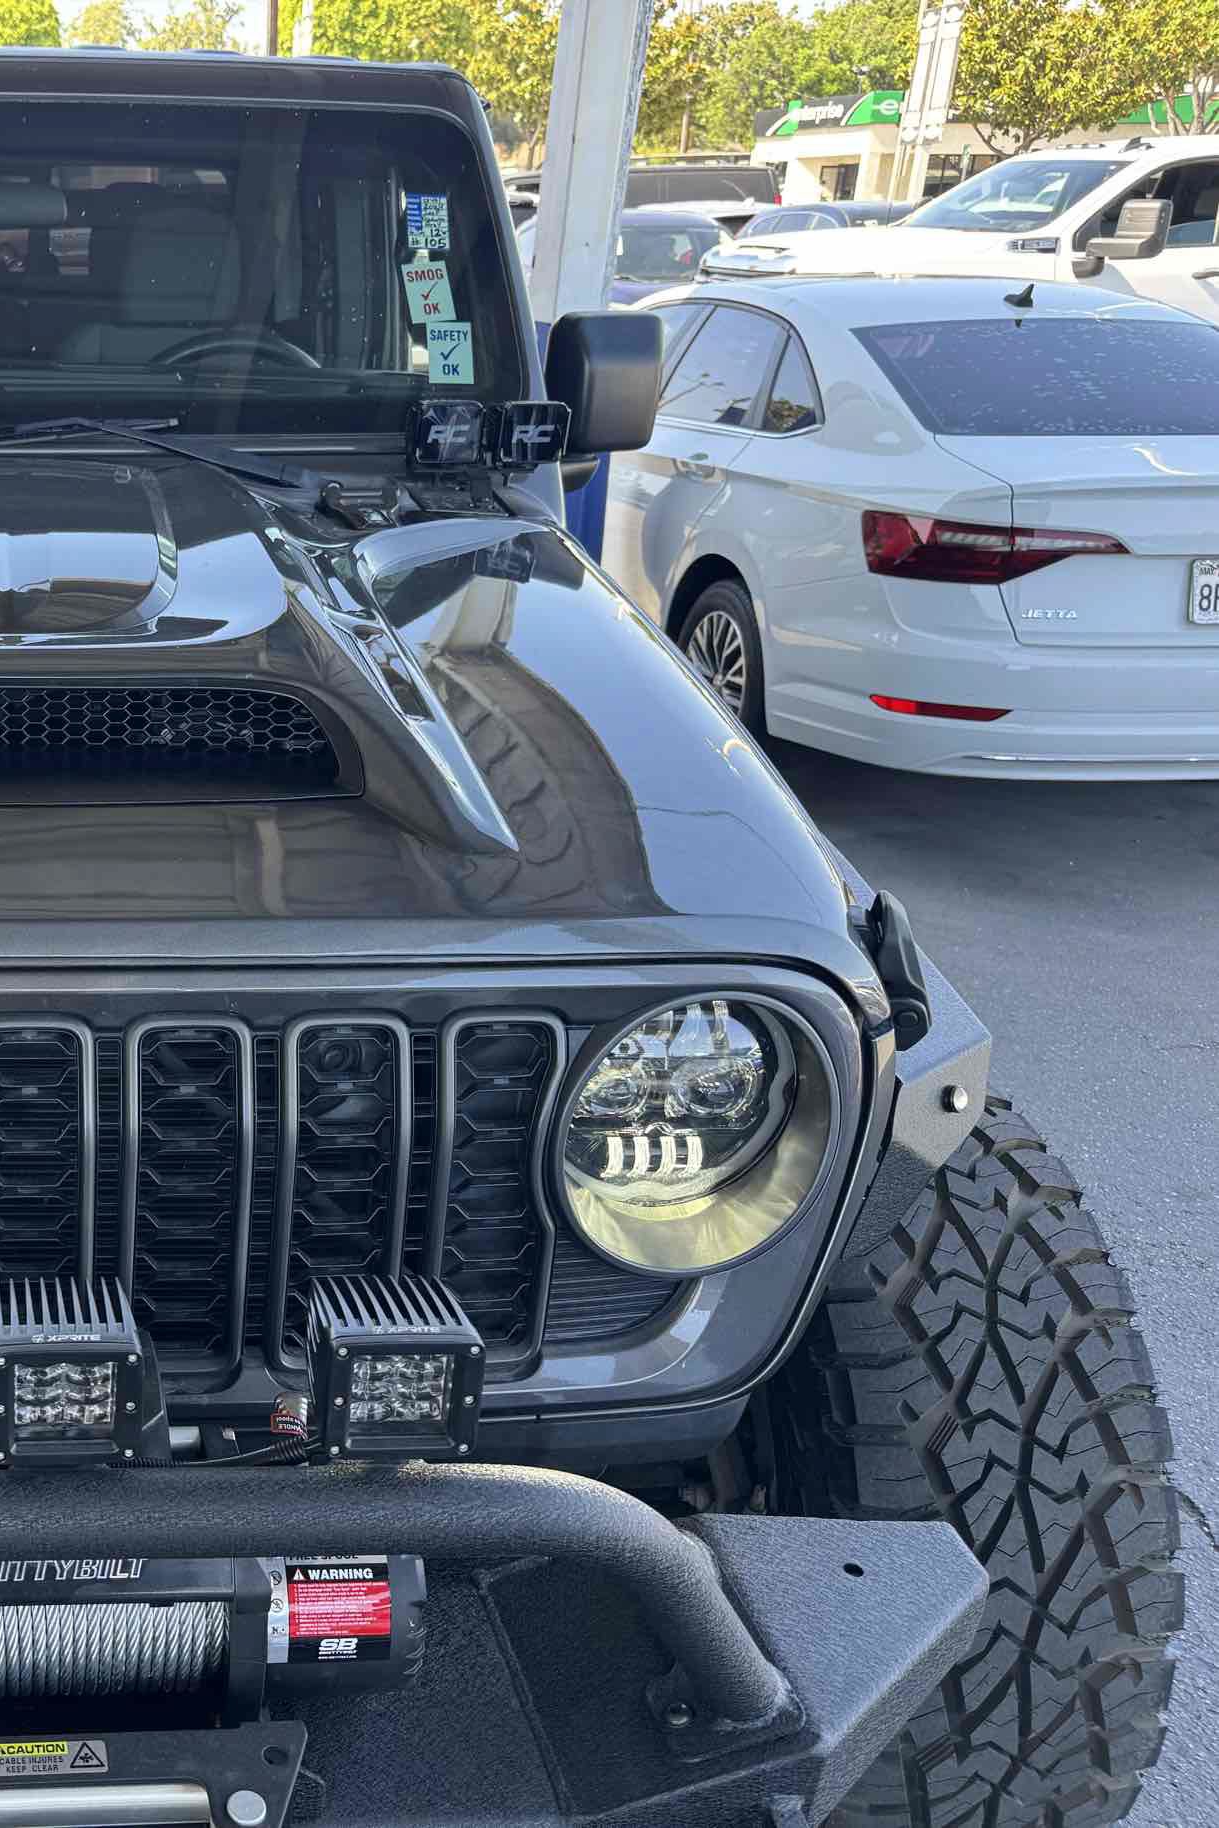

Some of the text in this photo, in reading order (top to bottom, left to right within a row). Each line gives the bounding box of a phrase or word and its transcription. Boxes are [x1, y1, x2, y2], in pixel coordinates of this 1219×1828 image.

[405, 268, 444, 282] SMOG
[423, 302, 440, 315] OK
[429, 329, 468, 342] SAFETY
[442, 363, 460, 376] OK
[1198, 567, 1214, 576] MAY
[1021, 608, 1078, 619] JETTA
[308, 1567, 375, 1580] WARNING
[319, 1638, 359, 1651] SB
[6, 1743, 66, 1755] CAUTION
[0, 1757, 27, 1766] CABLE
[31, 1764, 60, 1773] CLEAR
